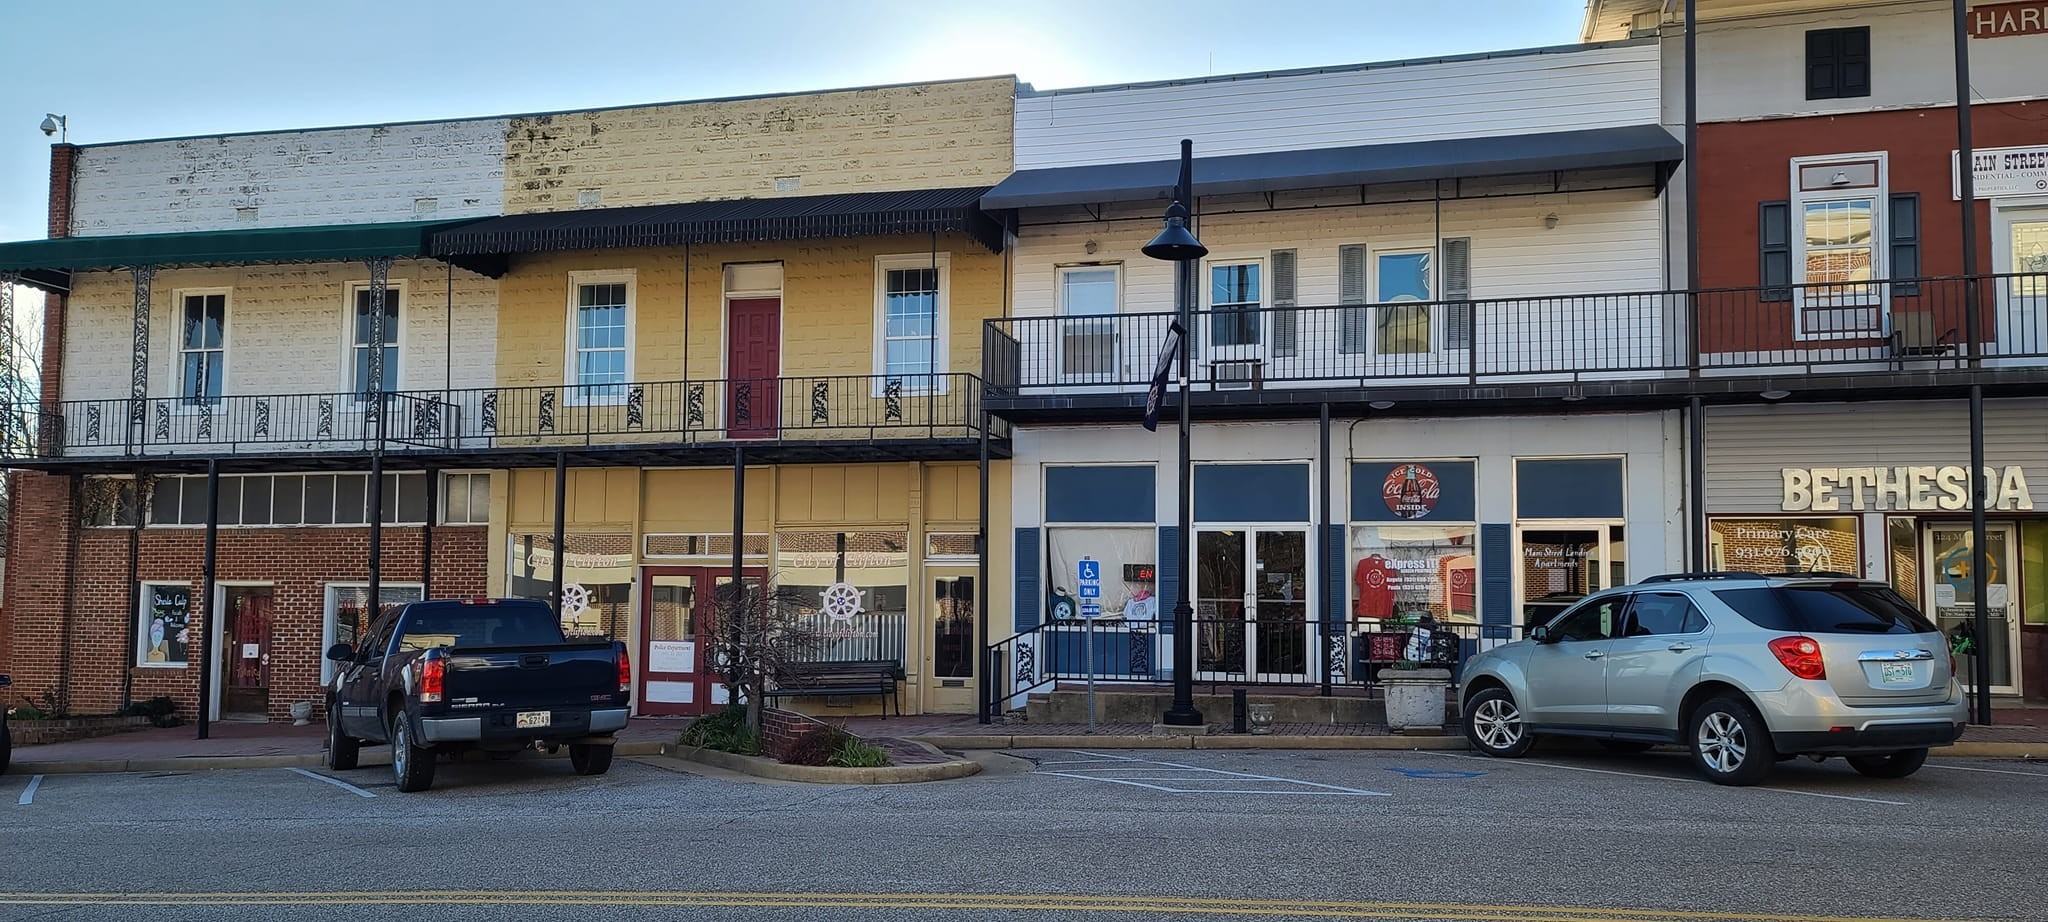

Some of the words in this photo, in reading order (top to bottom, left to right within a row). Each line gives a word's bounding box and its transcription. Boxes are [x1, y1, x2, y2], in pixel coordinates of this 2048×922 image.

[1973, 155, 1996, 171] AIN
[1972, 172, 2014, 180] SIDENTIAL
[1391, 468, 1406, 478] ICE
[1410, 467, 1433, 478] COLD
[1781, 465, 2033, 511] BETHESDA
[1736, 527, 1794, 541] Primary
[1795, 527, 1830, 539] Care
[1985, 532, 2003, 541] reet
[1525, 547, 1543, 556] Main
[1544, 547, 1563, 556] Street
[573, 553, 617, 570] Clifton
[793, 553, 820, 569] City
[826, 552, 842, 569] of
[844, 552, 892, 569] Clifton
[1534, 559, 1578, 569] Apartments
[1079, 578, 1099, 586] PARKING
[1083, 587, 1096, 596] ONLY
